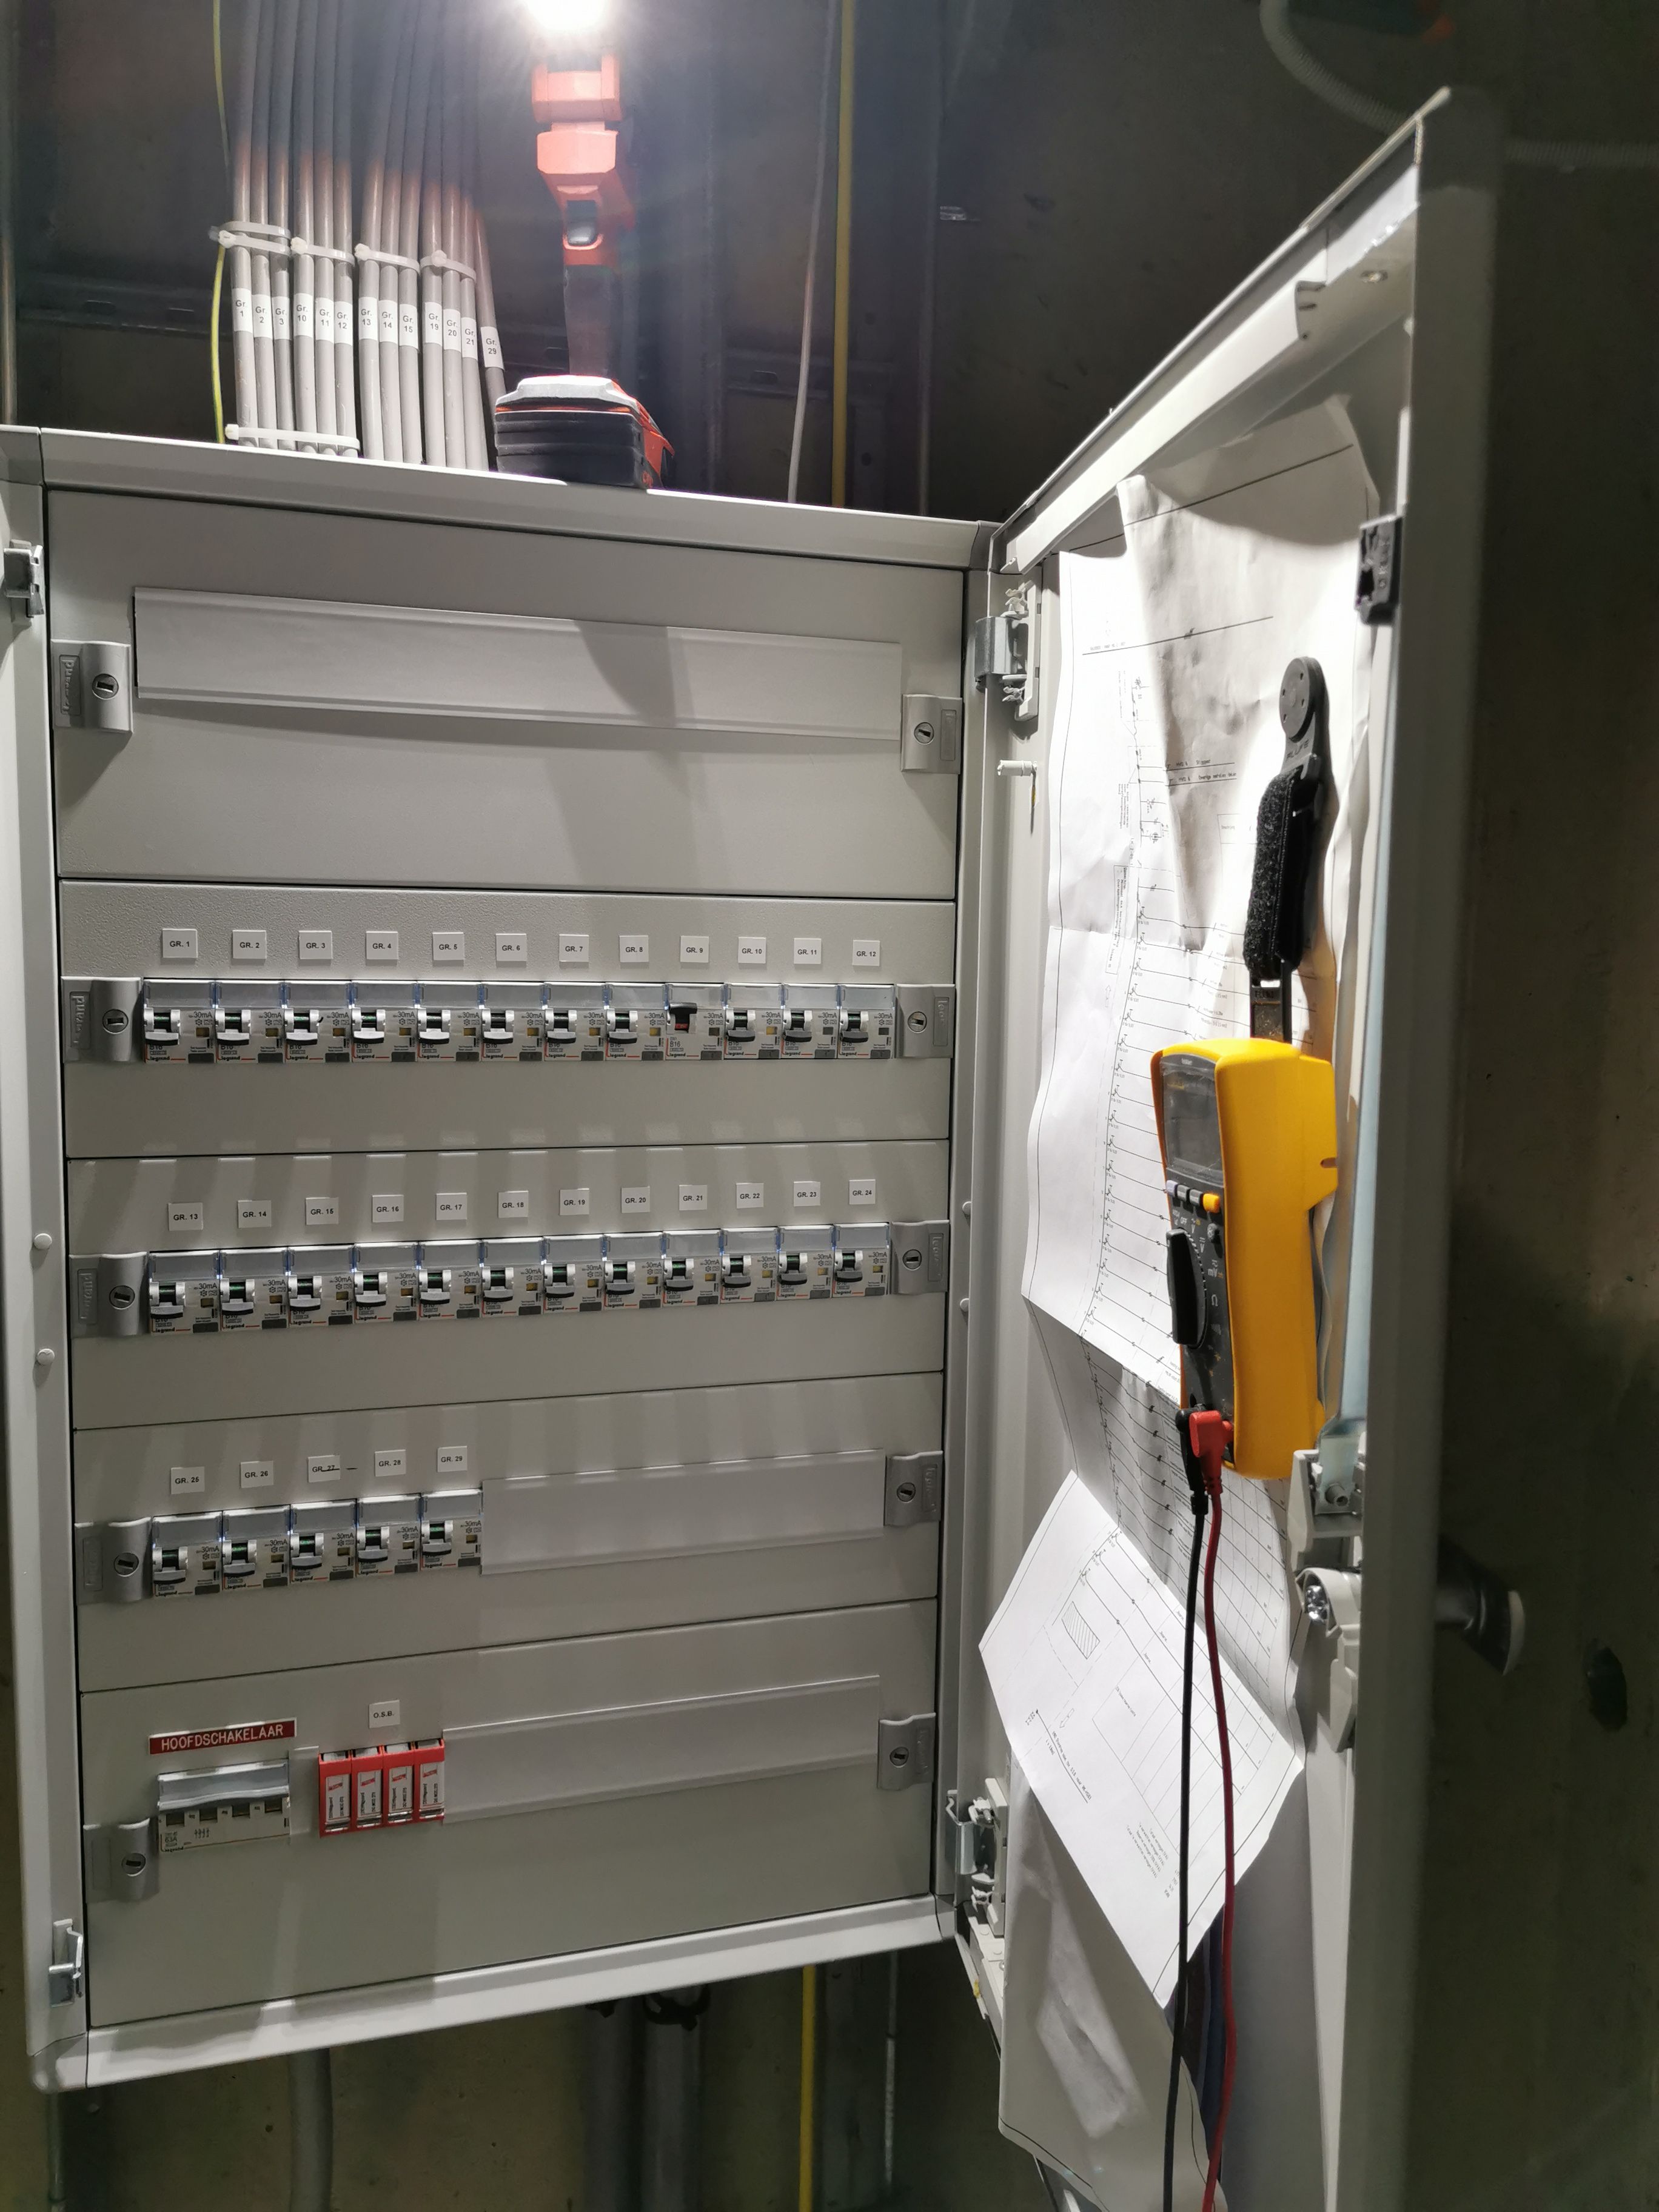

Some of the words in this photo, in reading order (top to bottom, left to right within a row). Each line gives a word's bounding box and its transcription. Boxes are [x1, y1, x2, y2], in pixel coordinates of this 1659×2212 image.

[320, 309, 331, 318] Gr.
[337, 312, 348, 320] Gr.
[464, 328, 475, 337] Gr.
[373, 1710, 395, 1719] O.S.B.
[161, 1724, 284, 1751] HOOFDSCHAKELAAR
